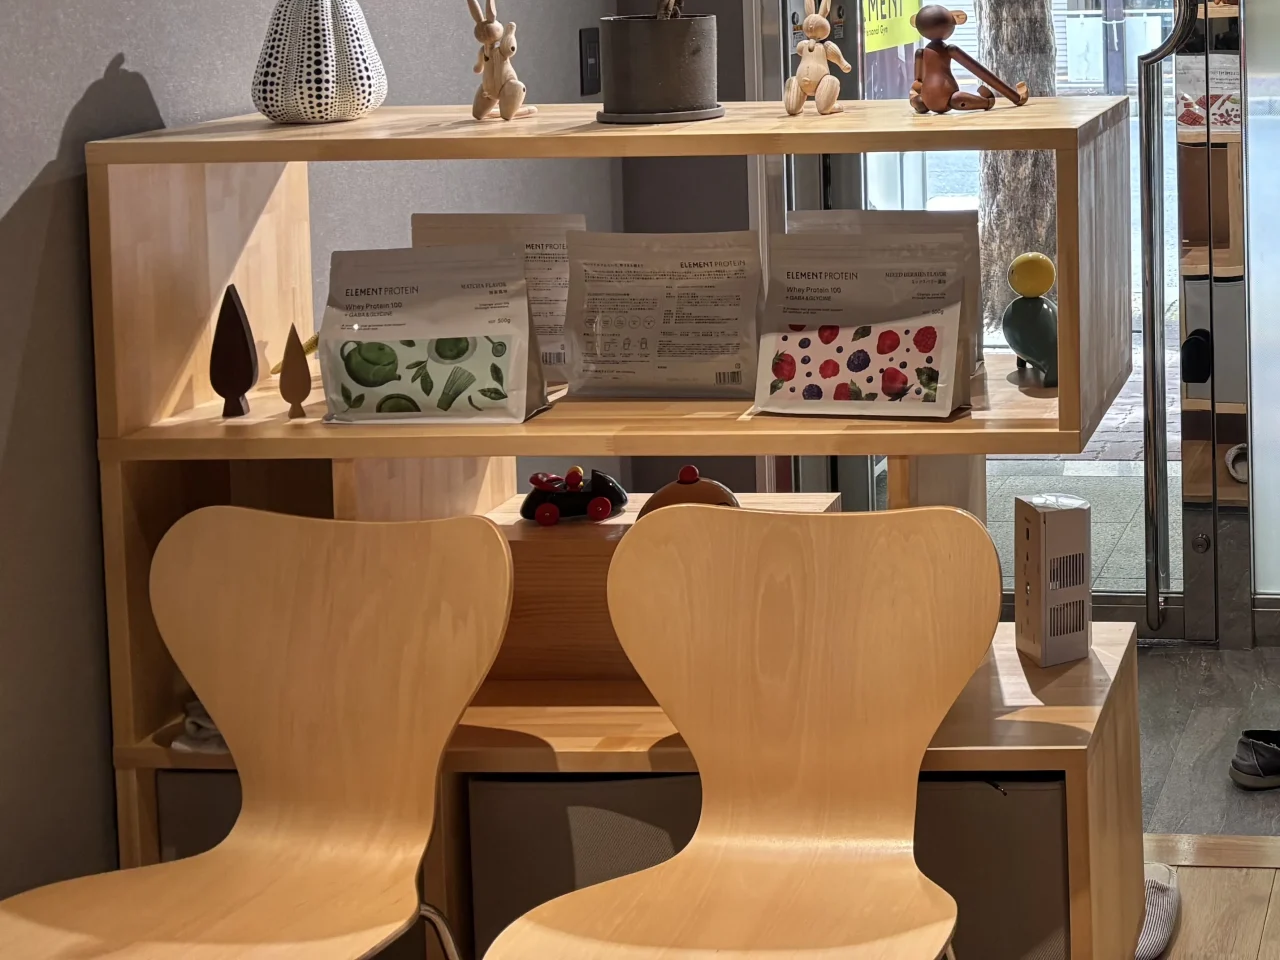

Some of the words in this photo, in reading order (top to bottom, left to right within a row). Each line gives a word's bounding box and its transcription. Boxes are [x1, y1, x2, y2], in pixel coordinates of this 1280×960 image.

[680, 260, 714, 269] ELEMENT
[714, 259, 746, 268] PROTEIN
[786, 271, 823, 280] ELEMENT
[824, 271, 858, 281] PROTEIN
[345, 287, 383, 297] ELEMENT
[383, 285, 419, 296] PROTEIN
[786, 286, 805, 294] Whey
[345, 303, 365, 311] Whey
[365, 302, 390, 310] Protein
[390, 301, 403, 309] 100
